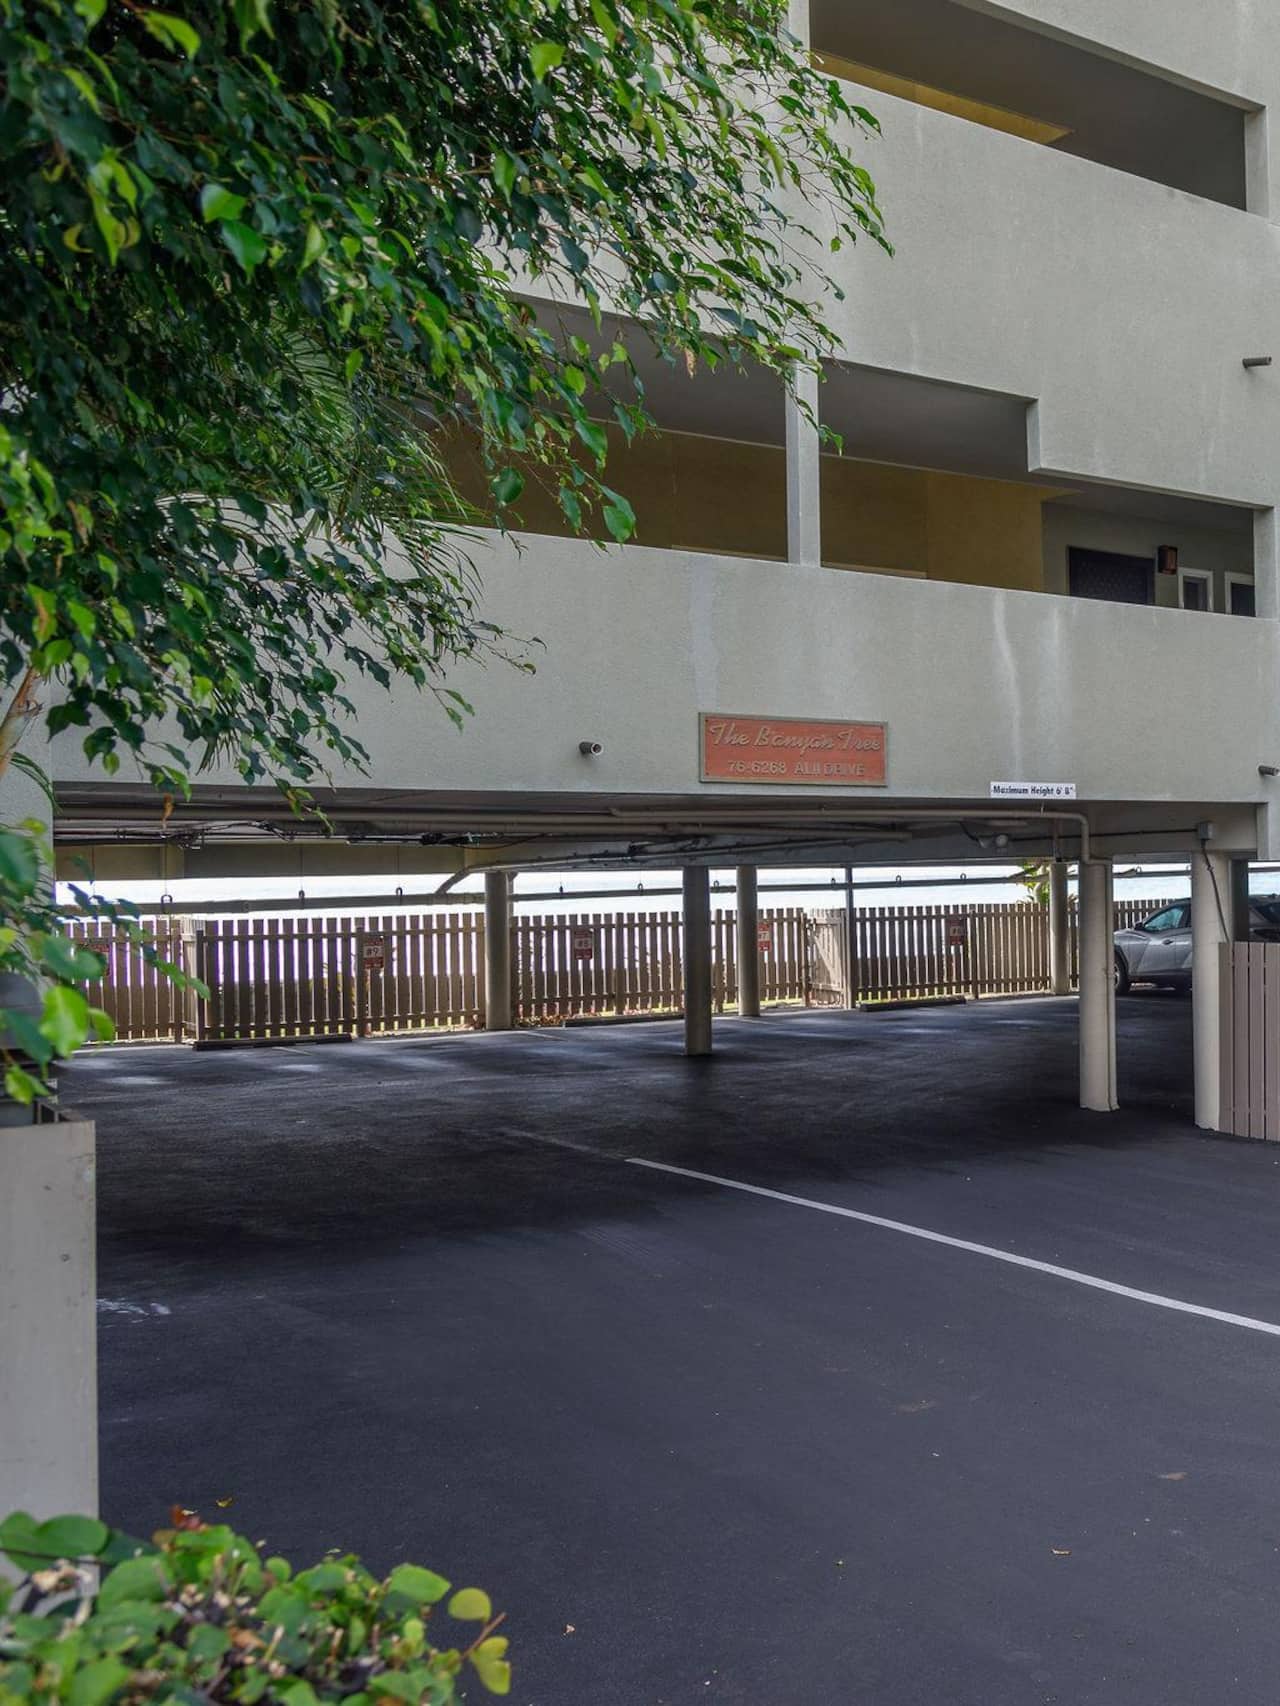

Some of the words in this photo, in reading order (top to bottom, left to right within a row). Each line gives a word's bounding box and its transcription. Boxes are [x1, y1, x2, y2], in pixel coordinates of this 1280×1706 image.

[709, 722, 750, 746] The
[753, 725, 833, 757] Banyan
[837, 728, 880, 752] Tree
[993, 785, 1028, 794] Maximum
[1031, 785, 1054, 797] Height
